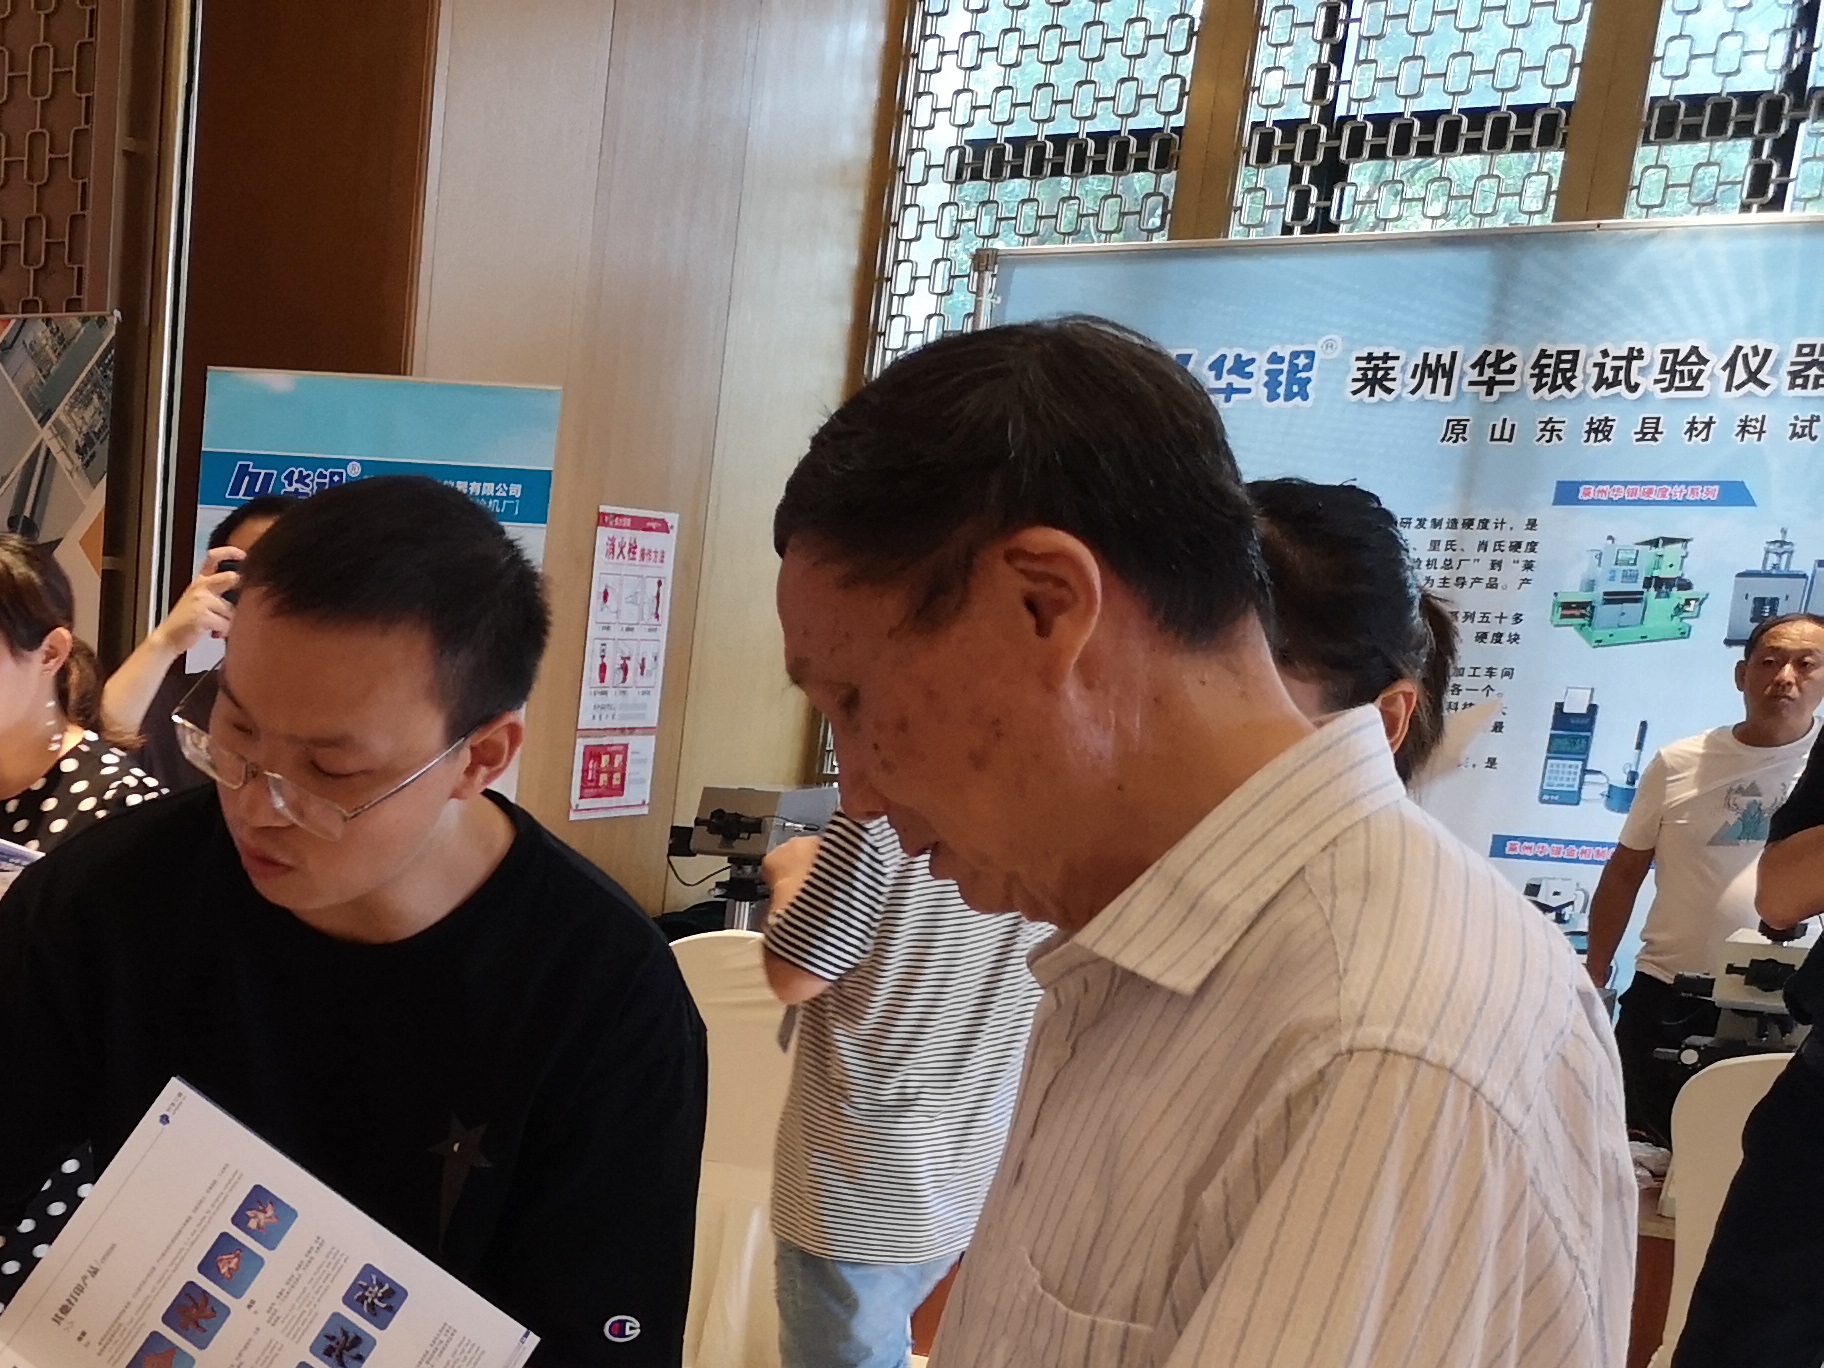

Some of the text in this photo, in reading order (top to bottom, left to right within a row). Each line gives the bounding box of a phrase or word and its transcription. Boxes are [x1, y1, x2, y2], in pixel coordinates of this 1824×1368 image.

[1350, 343, 1824, 398] 莱州华银试验仪器
[1440, 414, 1821, 444] 原山东掖县材料试
[605, 535, 638, 561] 消火栓
